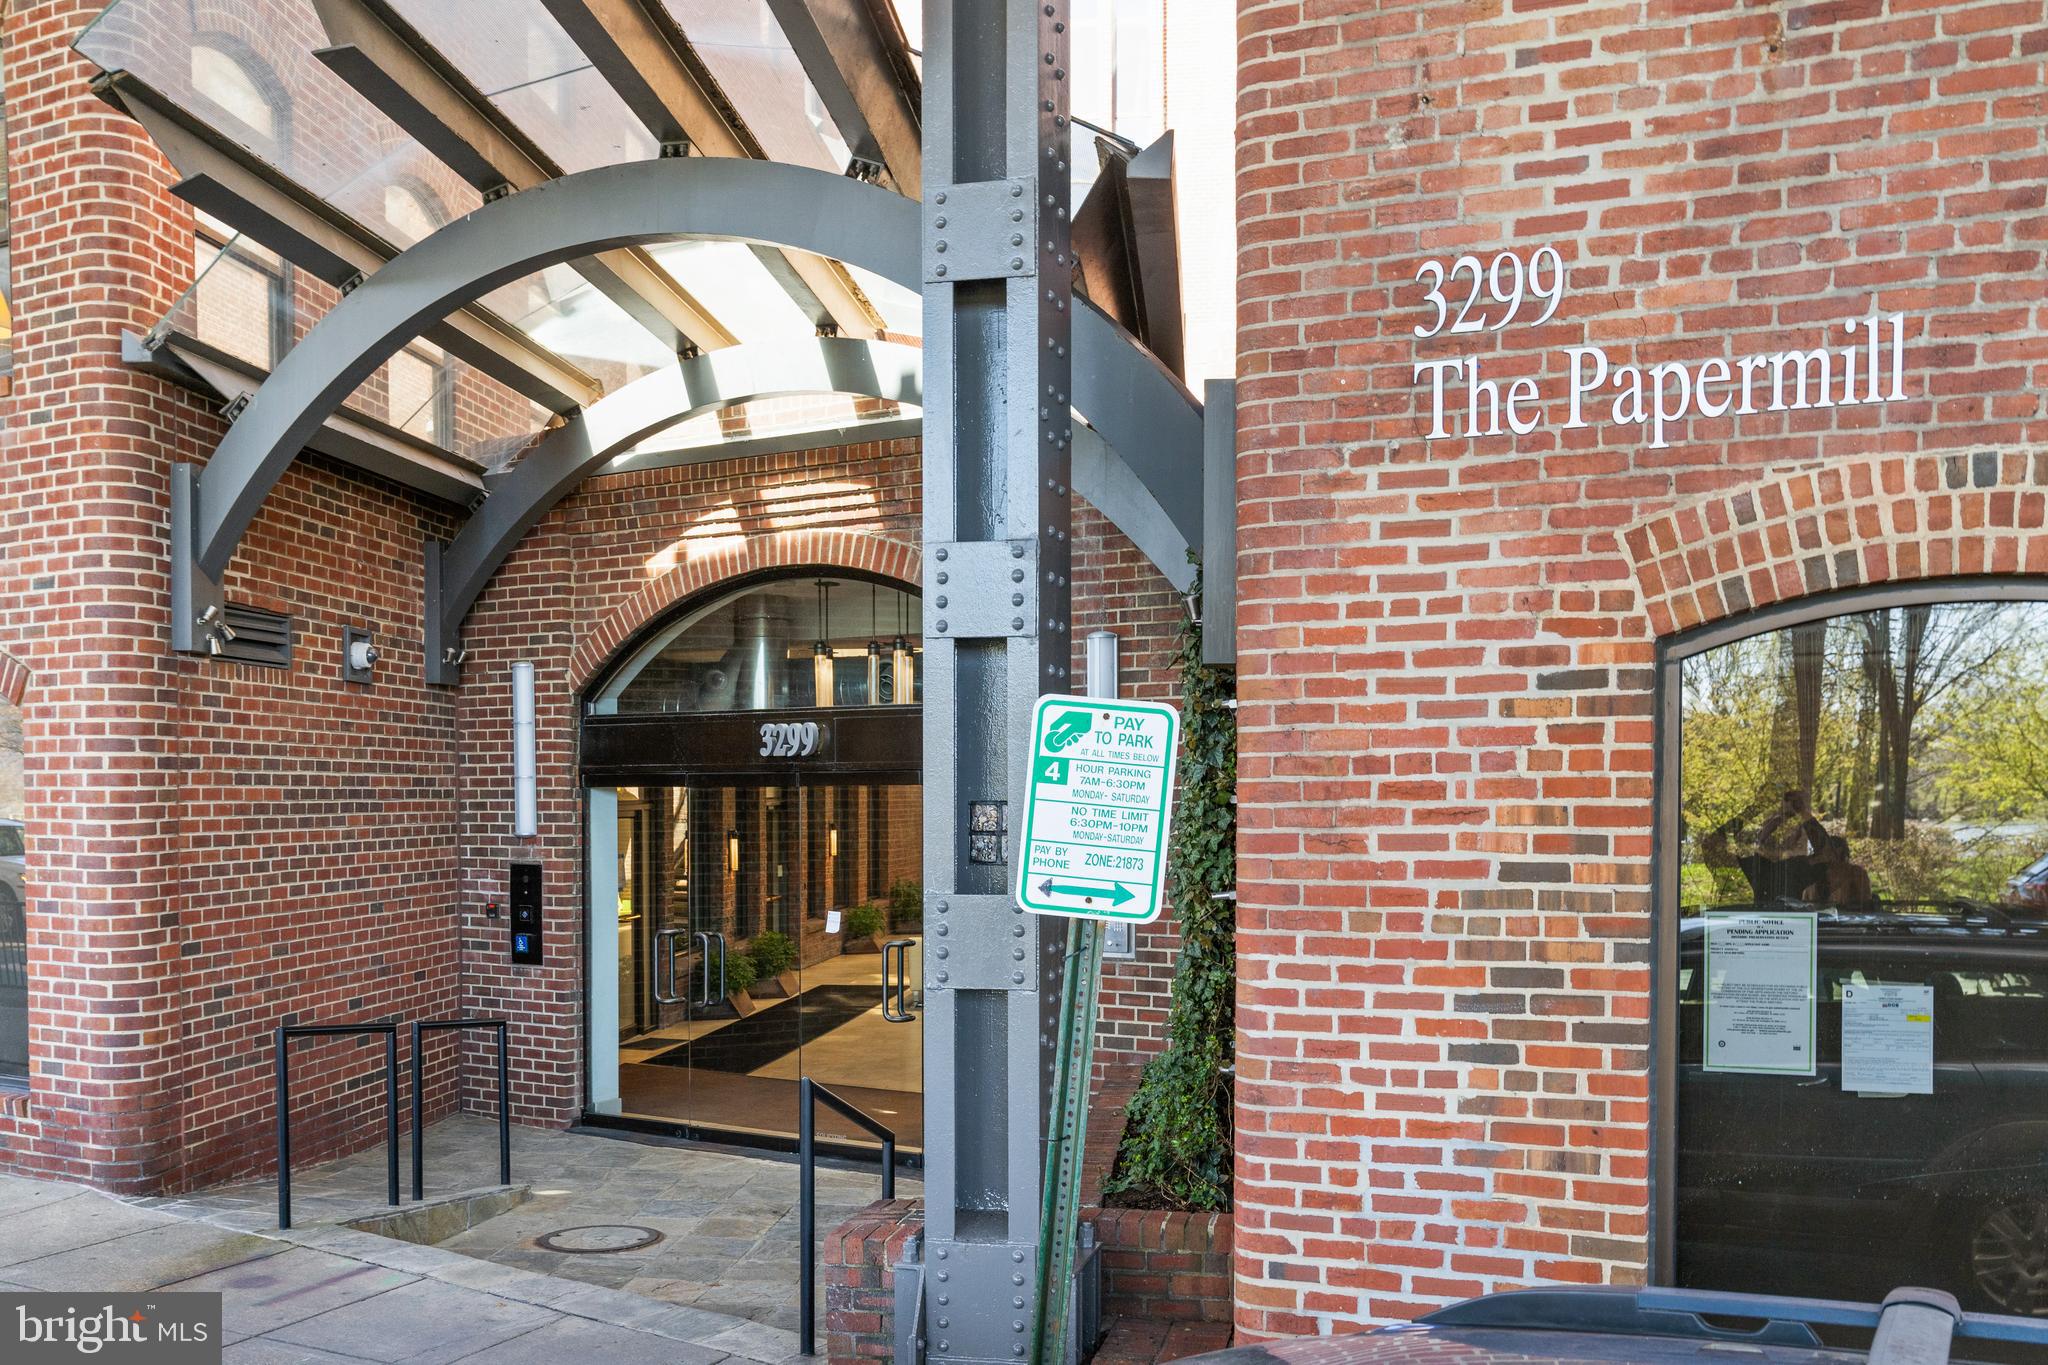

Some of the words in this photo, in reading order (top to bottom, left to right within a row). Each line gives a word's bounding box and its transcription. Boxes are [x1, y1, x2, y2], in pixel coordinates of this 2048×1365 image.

[1413, 247, 1564, 338] 3299
[1413, 355, 1541, 440] The
[1563, 312, 1908, 449] Papermill
[1114, 716, 1145, 731] PAY
[759, 722, 819, 757] 3299
[1095, 731, 1112, 745] TO
[1118, 733, 1154, 749] PARK
[1080, 748, 1089, 756] AT
[1091, 749, 1105, 758] ALL
[1108, 751, 1130, 760] TIMES
[1133, 752, 1160, 763] BELOW
[1044, 761, 1061, 781] 4
[1076, 764, 1104, 775] HOUR
[1108, 766, 1152, 779] PARKING
[1079, 776, 1146, 790] 7AM-6:30PM
[1111, 793, 1150, 805] SATURDAY
[1071, 806, 1088, 816] NO
[1092, 808, 1117, 818] TIME
[1121, 810, 1150, 822] LIMIT
[1070, 818, 1149, 833] 6:30PM-10PM
[1072, 830, 1144, 845] MONDAY-SATURDAY
[1034, 845, 1052, 855] PAY
[1055, 847, 1069, 856] BY
[1032, 857, 1071, 869] PHONE
[1085, 853, 1144, 871] ZONE:21873
